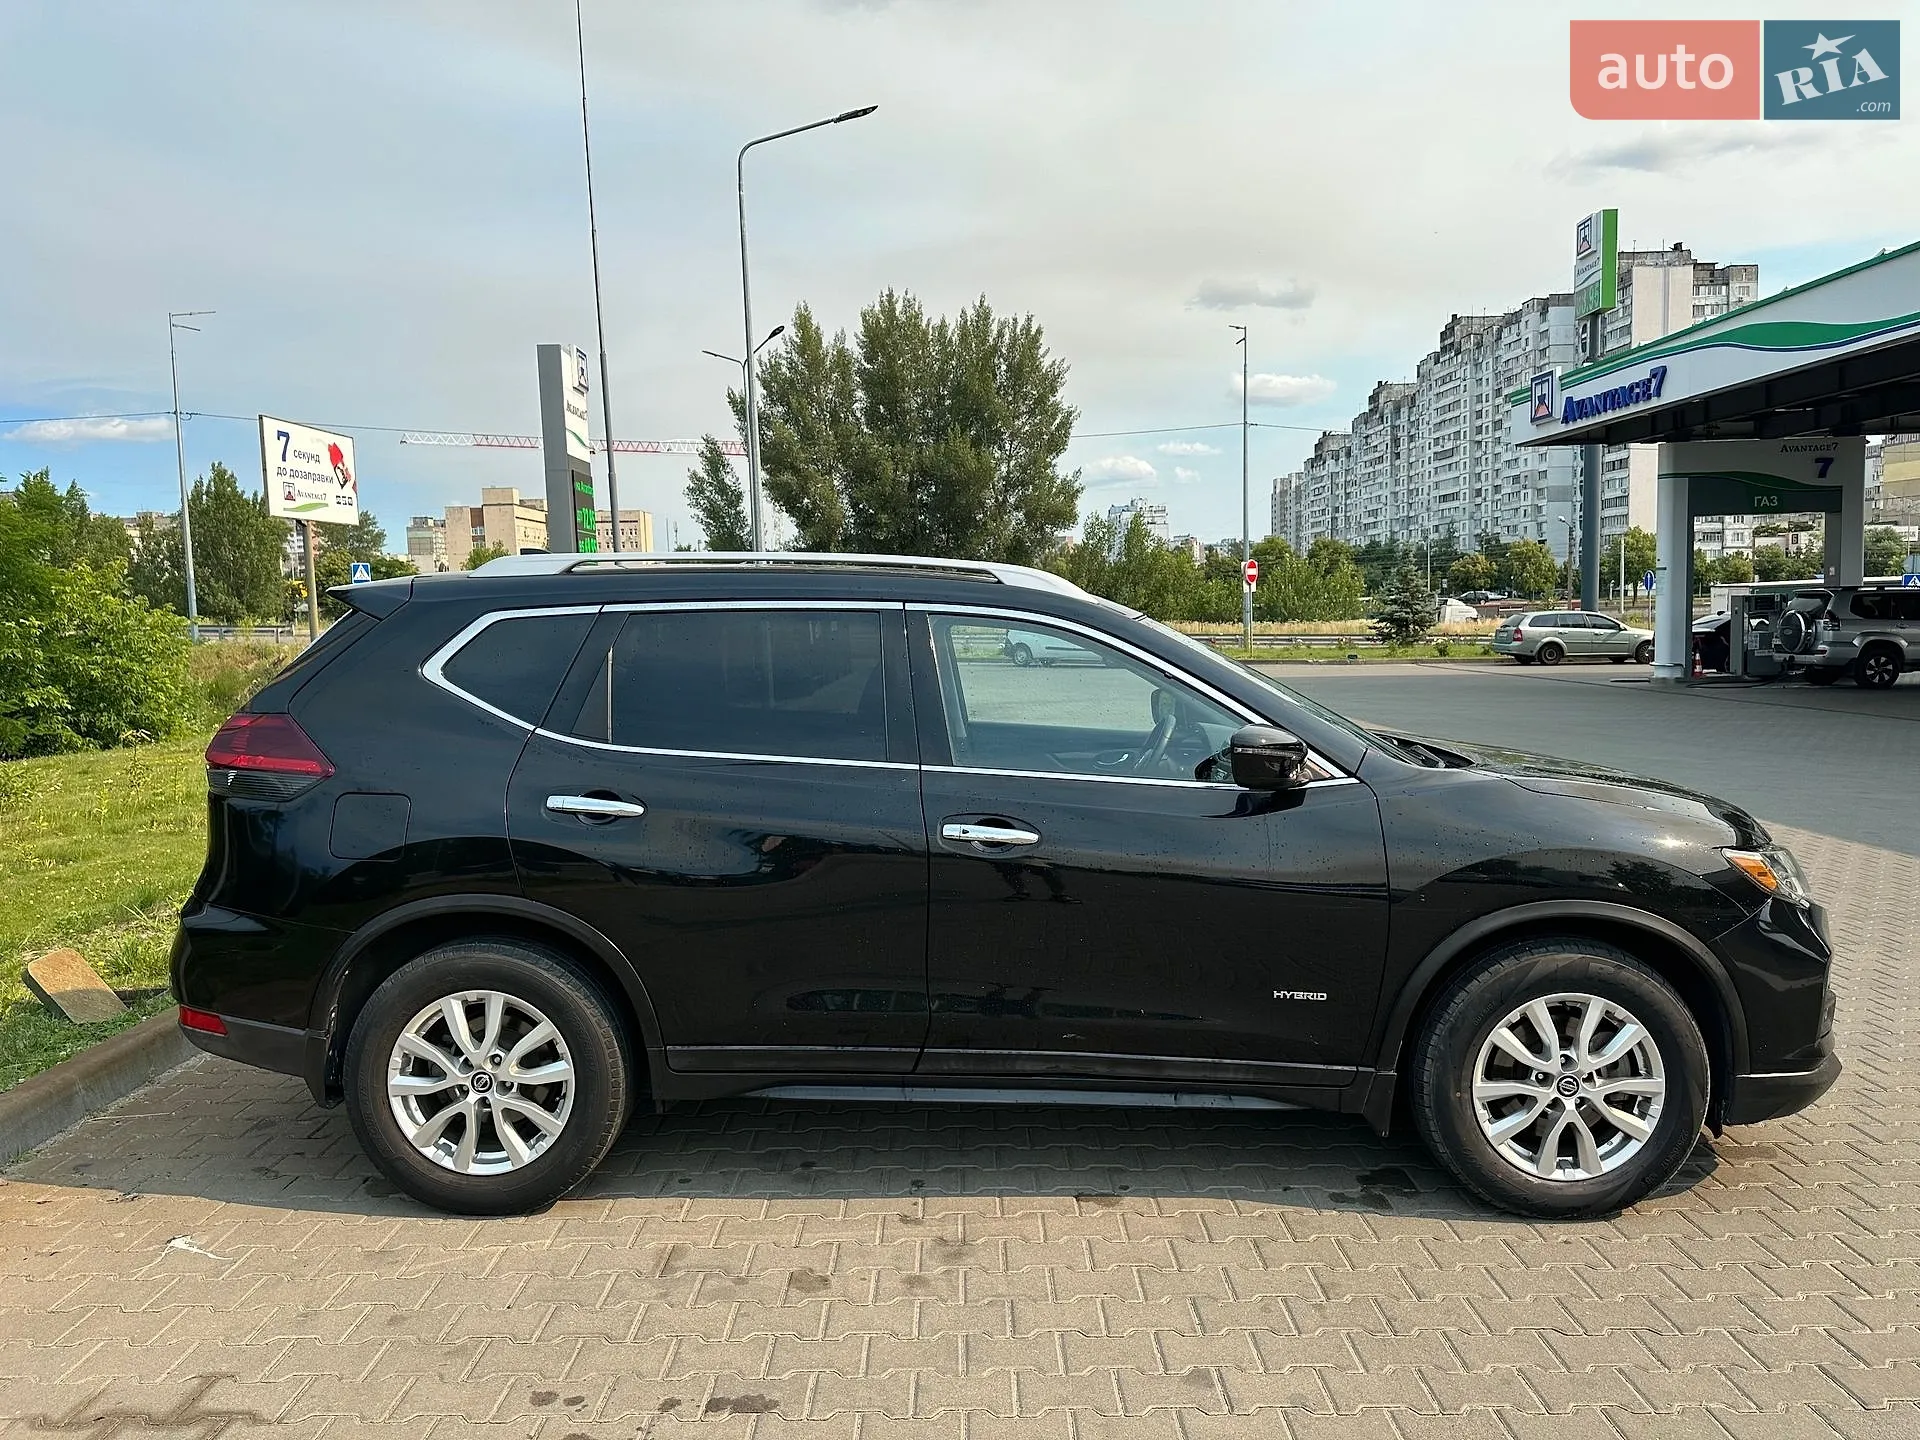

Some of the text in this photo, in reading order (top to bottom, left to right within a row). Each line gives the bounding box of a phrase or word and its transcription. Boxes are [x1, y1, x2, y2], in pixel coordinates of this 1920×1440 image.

[1560, 365, 1668, 425] AVANTAGE7
[276, 429, 321, 464] 7 секунд
[1780, 442, 1839, 453] AVANTAGE7
[276, 466, 334, 484] до дозаправки
[1814, 457, 1834, 479] 7
[1754, 495, 1778, 508] ГАЗ
[1273, 990, 1327, 1001] HYBRID
